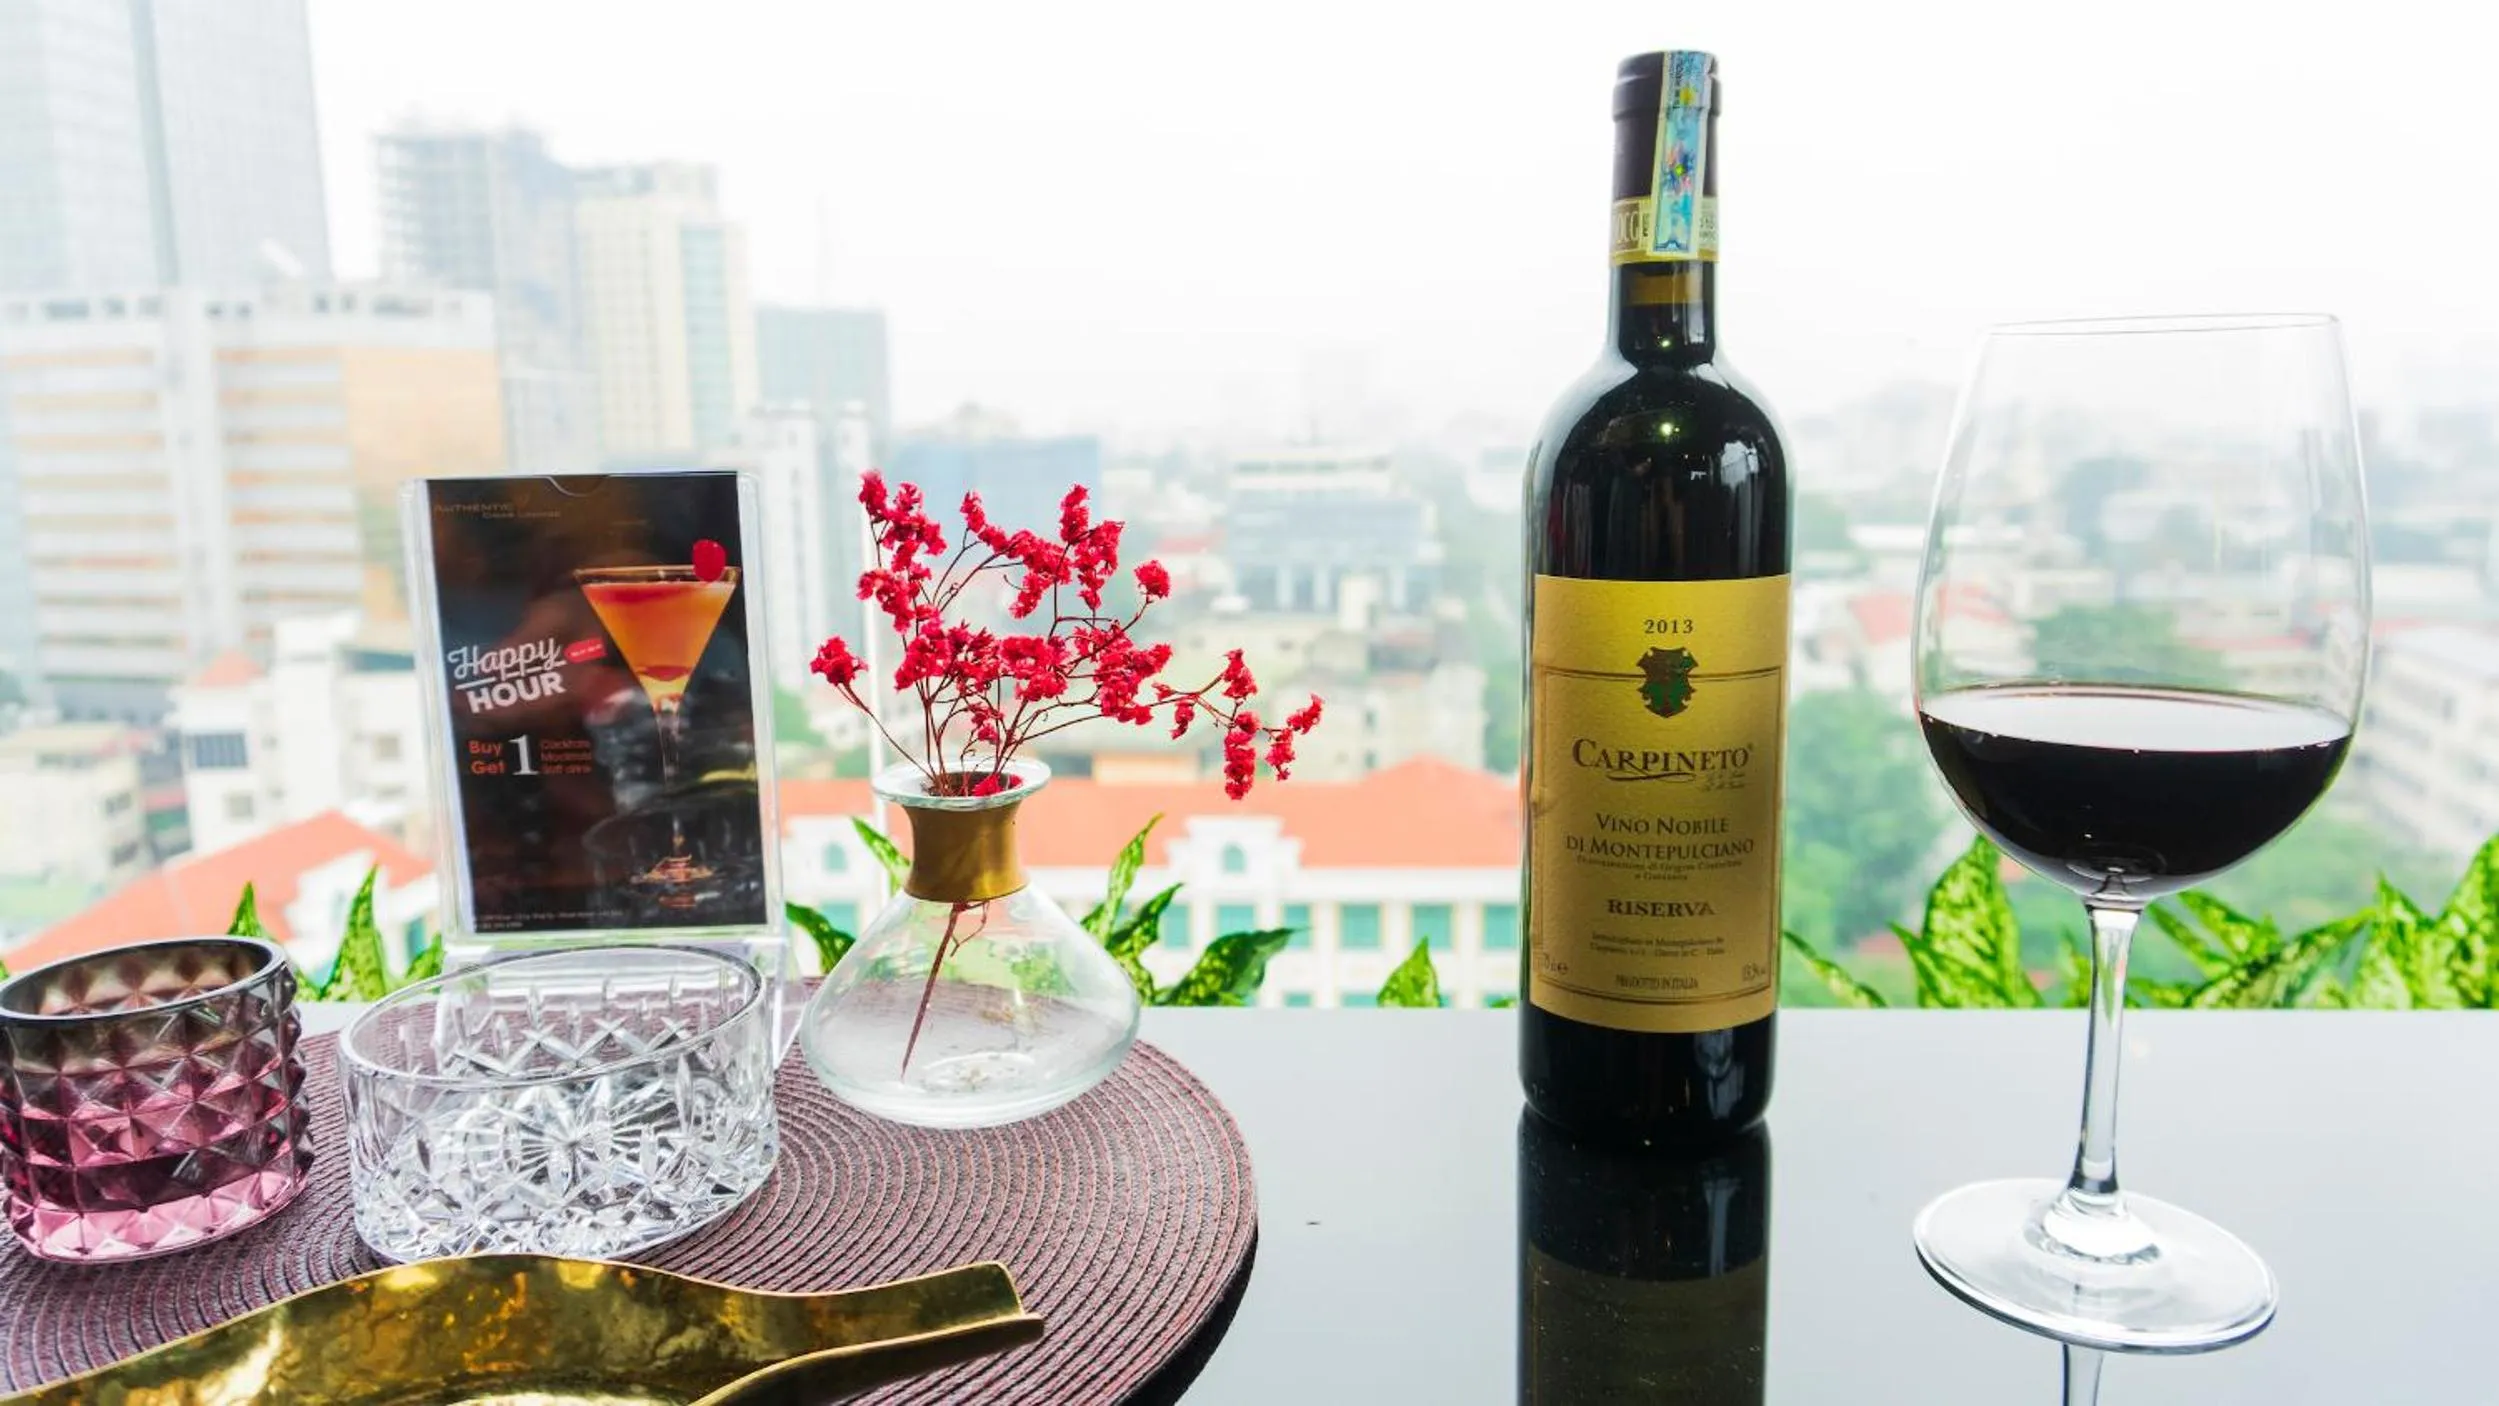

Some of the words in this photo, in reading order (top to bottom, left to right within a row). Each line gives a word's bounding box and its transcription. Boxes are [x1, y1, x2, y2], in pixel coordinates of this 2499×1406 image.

[1644, 619, 1694, 634] 2013
[447, 637, 561, 681] Happy
[466, 671, 566, 713] HOUR
[468, 740, 502, 757] Buy
[508, 734, 539, 775] 1
[1572, 738, 1750, 774] CARPINETO
[471, 760, 505, 775] Get
[1596, 813, 1649, 835] VINO
[1657, 816, 1730, 836] NOBILE
[1566, 836, 1585, 851] DI
[1589, 837, 1755, 860] MONTEPULCIANO
[1607, 899, 1716, 917] RISERVA
